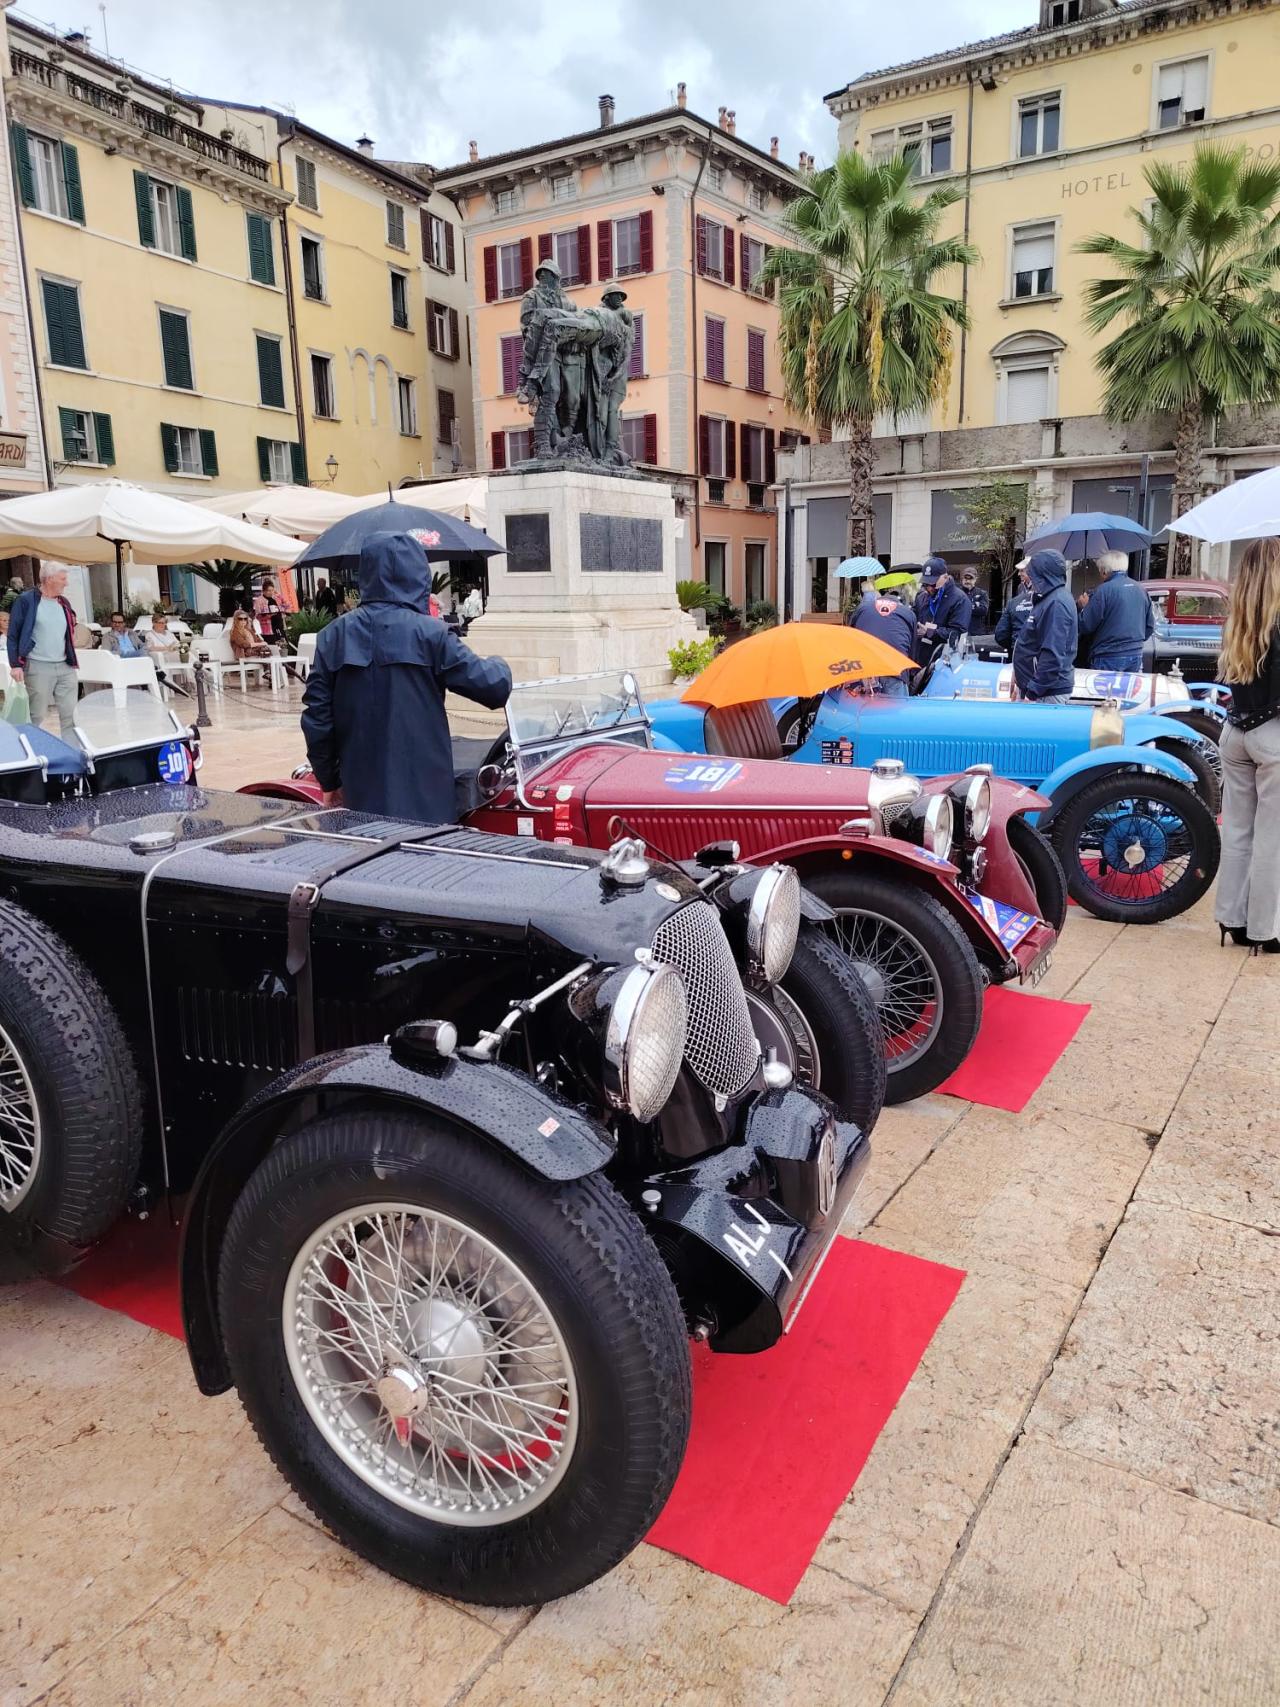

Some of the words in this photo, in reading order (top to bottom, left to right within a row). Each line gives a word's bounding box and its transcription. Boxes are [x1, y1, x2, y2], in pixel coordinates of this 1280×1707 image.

[1061, 173, 1131, 199] HOTEL
[167, 752, 184, 774] 10
[684, 766, 727, 782] 18
[723, 1202, 772, 1269] ALJ
